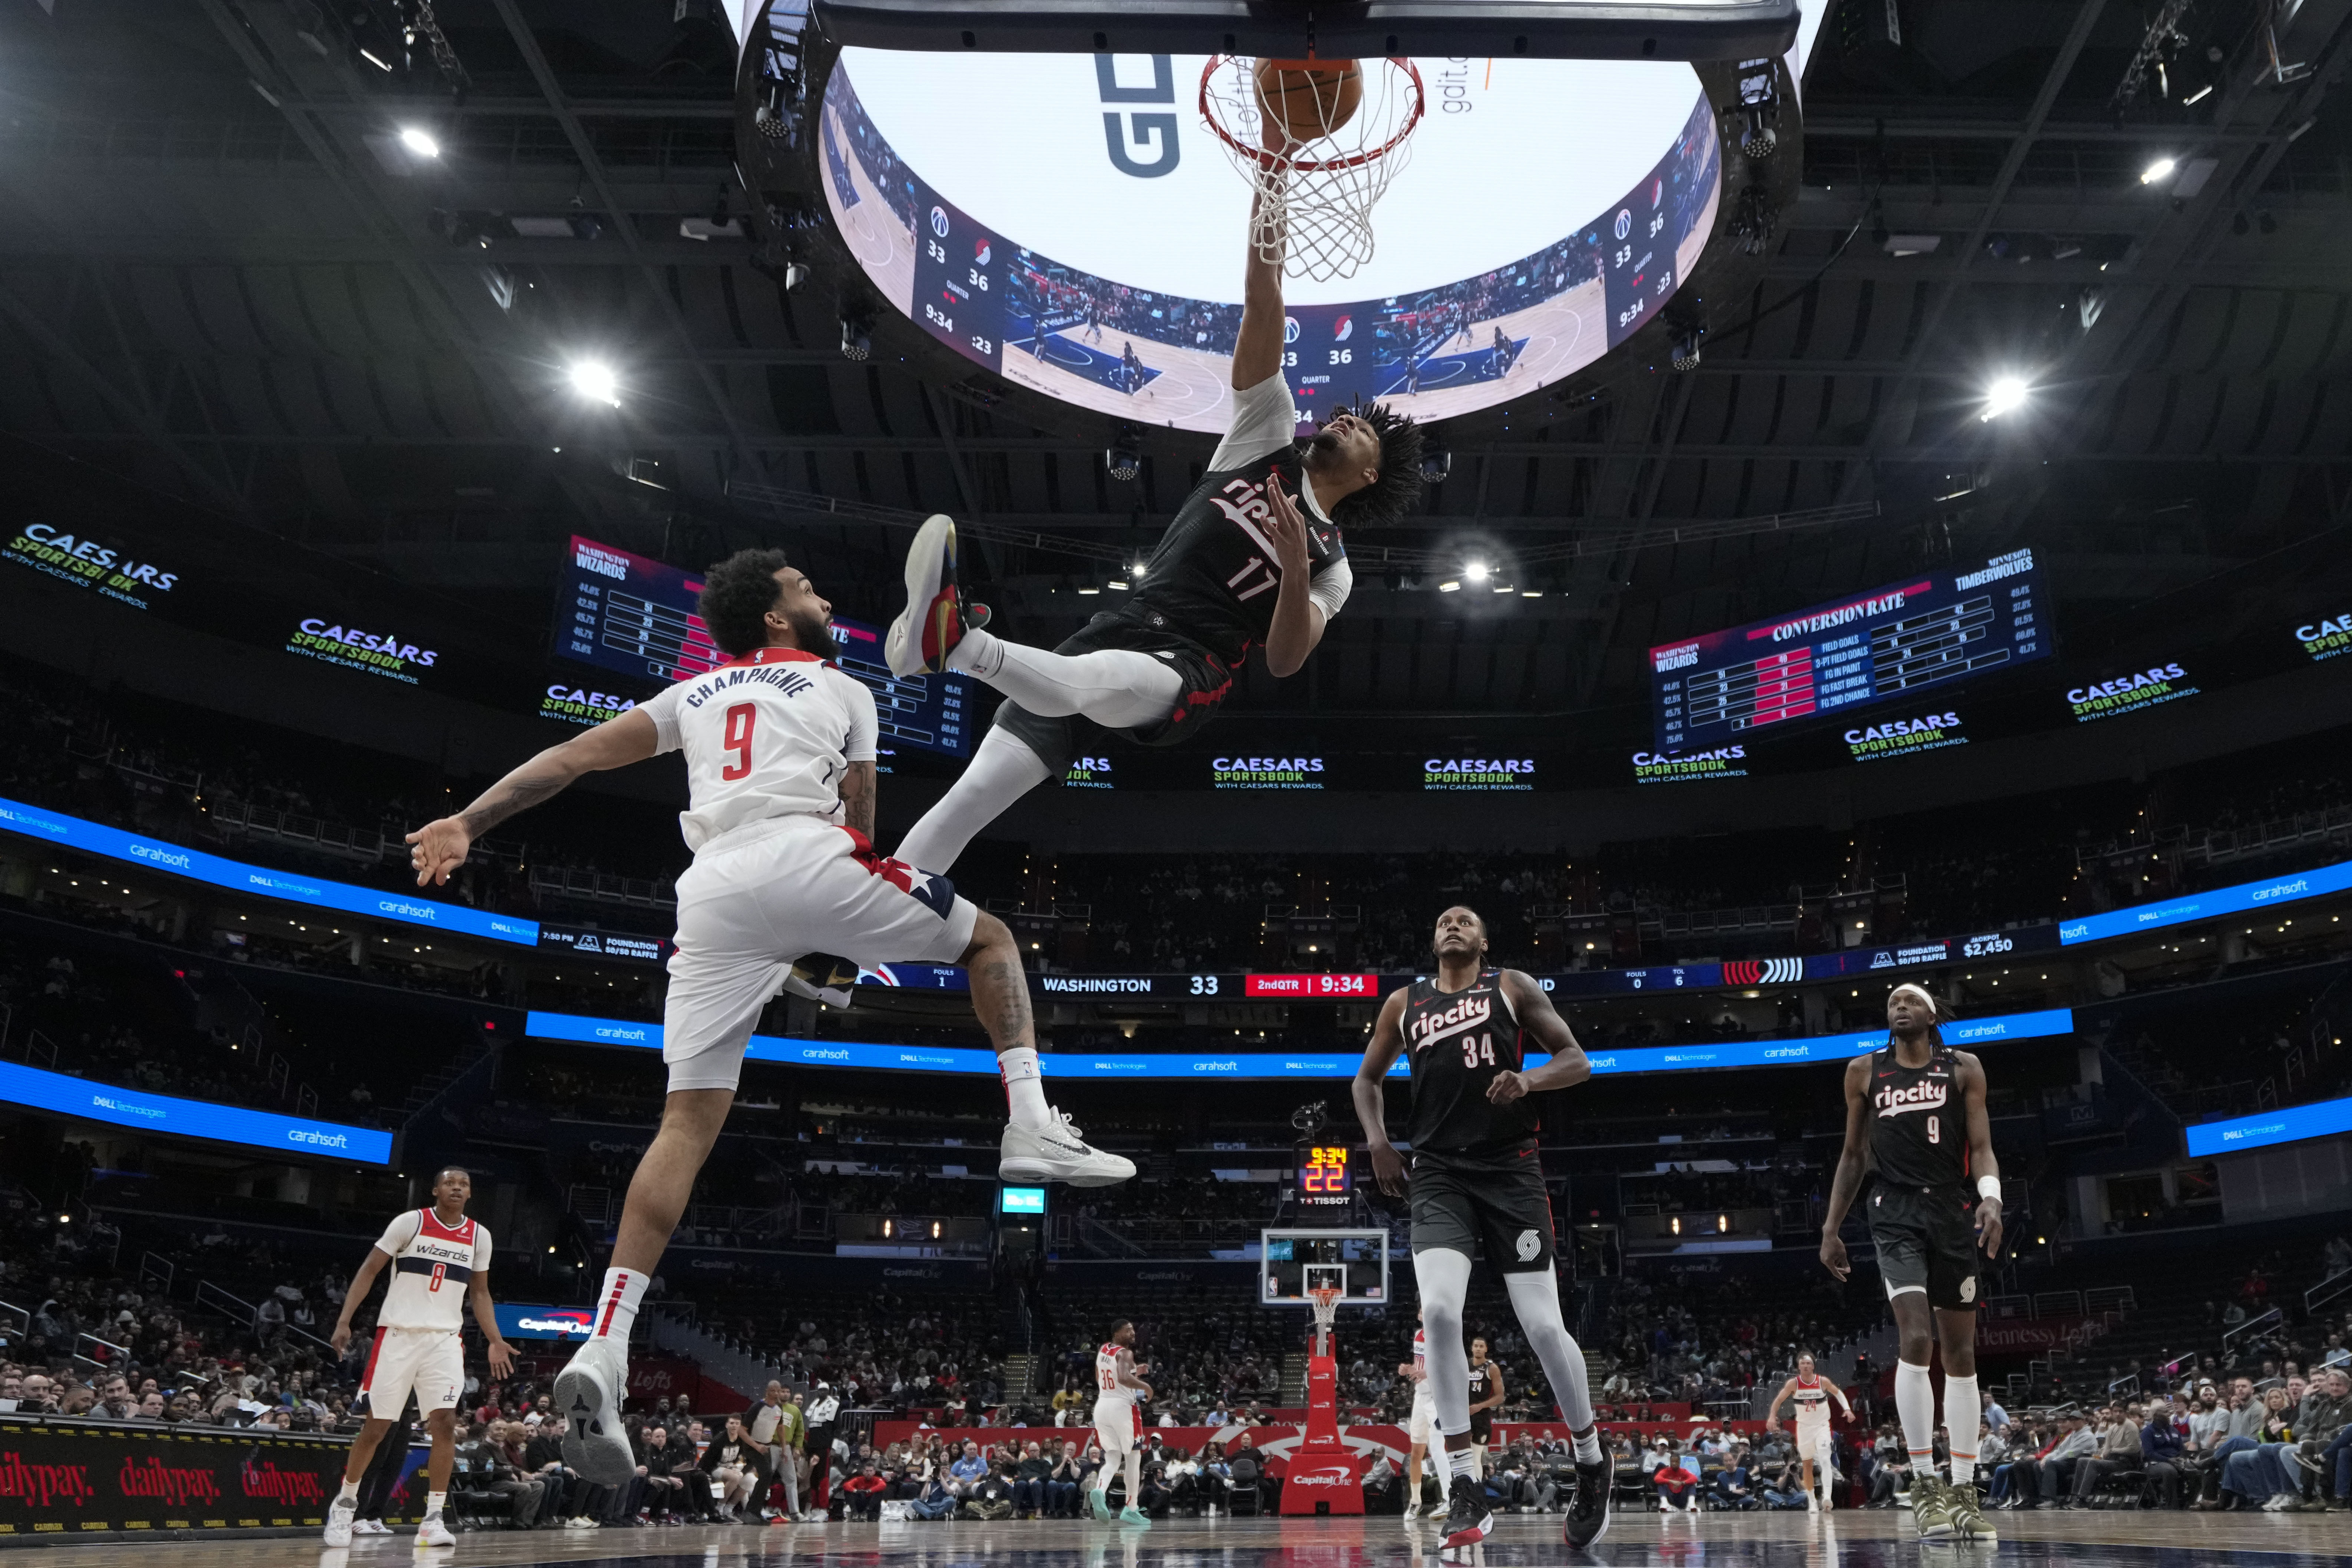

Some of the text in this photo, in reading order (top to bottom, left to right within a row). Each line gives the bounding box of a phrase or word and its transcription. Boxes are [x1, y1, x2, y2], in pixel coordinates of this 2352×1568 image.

[1650, 212, 1664, 239] 36
[928, 239, 945, 263] 33
[1616, 244, 1632, 269] 33
[1635, 251, 1653, 273] QUARTER
[969, 268, 988, 292] 36
[946, 279, 969, 301] QUARTER
[926, 304, 953, 333] 9:34
[1619, 298, 1644, 328] 9:34
[1329, 348, 1352, 365] 36
[1302, 375, 1330, 384] QUARTER
[1309, 526, 1330, 557] BRIGHTSIDE
[576, 551, 626, 581] WIZARDS
[1955, 556, 2034, 591] TIMBERWOLVES
[1227, 556, 1278, 602] 17
[1772, 591, 1905, 642] CONVERSION RATE
[291, 631, 406, 670] SPORTSBOOK
[1822, 634, 1860, 653] FIELD GOALS
[1656, 651, 1698, 673] WIZARDS
[1815, 645, 1868, 669] 3-PT FIELD GOALS
[1825, 661, 1861, 680] FG IN PAINT
[686, 667, 815, 709] CHAMPAGNIE
[1821, 674, 1868, 695] FG FAST BREAK
[1830, 687, 1871, 707] 2ND CHANCE
[2072, 681, 2172, 715] SPORTSBOOK
[722, 702, 757, 782] 9
[1850, 729, 1944, 755] SPORTSBOOK
[1855, 745, 1921, 762] WITH CAESARS
[1214, 772, 1303, 781] SPORTSBOOK
[1636, 760, 1726, 776] SPORTSBOOK
[1663, 773, 1702, 782] CAESARS
[1424, 773, 1514, 783] SPORTSBOOK
[129, 844, 190, 869] carahsoft
[249, 875, 273, 887] DELL
[2253, 880, 2308, 901] carahsoft
[379, 901, 436, 920] carahsoft
[2138, 912, 2159, 922] DELL
[491, 922, 511, 933] DELL
[561, 934, 574, 942] PM
[607, 937, 659, 951] FOUNDATION
[1970, 934, 2000, 943] JACKPOT
[605, 946, 658, 960] 50/50 RAFFLE
[1898, 944, 1946, 957] FOUNDATION
[1963, 938, 2013, 958] $2,450
[1898, 952, 1947, 965] 50/50 RAFFLE
[939, 976, 945, 987] 1
[1042, 978, 1151, 992] WASHINGTON
[1189, 976, 1219, 995] 33
[1257, 979, 1299, 990] 2ndQTR
[1321, 976, 1364, 992] 9:34
[1633, 978, 1642, 989] 0
[1675, 976, 1683, 987] 6
[1411, 997, 1491, 1052] ripcity
[1959, 1024, 2006, 1038] carahsoft
[596, 1028, 647, 1041] carahsoft
[1858, 1040, 1875, 1048] DELL
[803, 1049, 851, 1060] carahsoft
[1462, 1033, 1495, 1069] 34
[1765, 1046, 1809, 1058] carahsoft
[1193, 1061, 1238, 1071] carahsoft
[93, 1095, 116, 1109] DELL
[1875, 1079, 1947, 1118] ripcity
[1927, 1115, 1940, 1144] 9
[2223, 1130, 2244, 1141] DELL
[288, 1130, 349, 1149] carahsoft
[1311, 1147, 1347, 1164] 9:34
[1305, 1163, 1344, 1191] 22
[1314, 1197, 1350, 1205] TISSOT
[416, 1243, 470, 1262] wizards
[429, 1262, 447, 1293] 8
[1101, 1369, 1115, 1390] 36
[1472, 1380, 1482, 1393] 24
[1804, 1399, 1817, 1412] 24
[120, 1456, 220, 1507] dailypay.
[242, 1461, 324, 1505] dailypay.
[1293, 1475, 1352, 1486] Capital One
